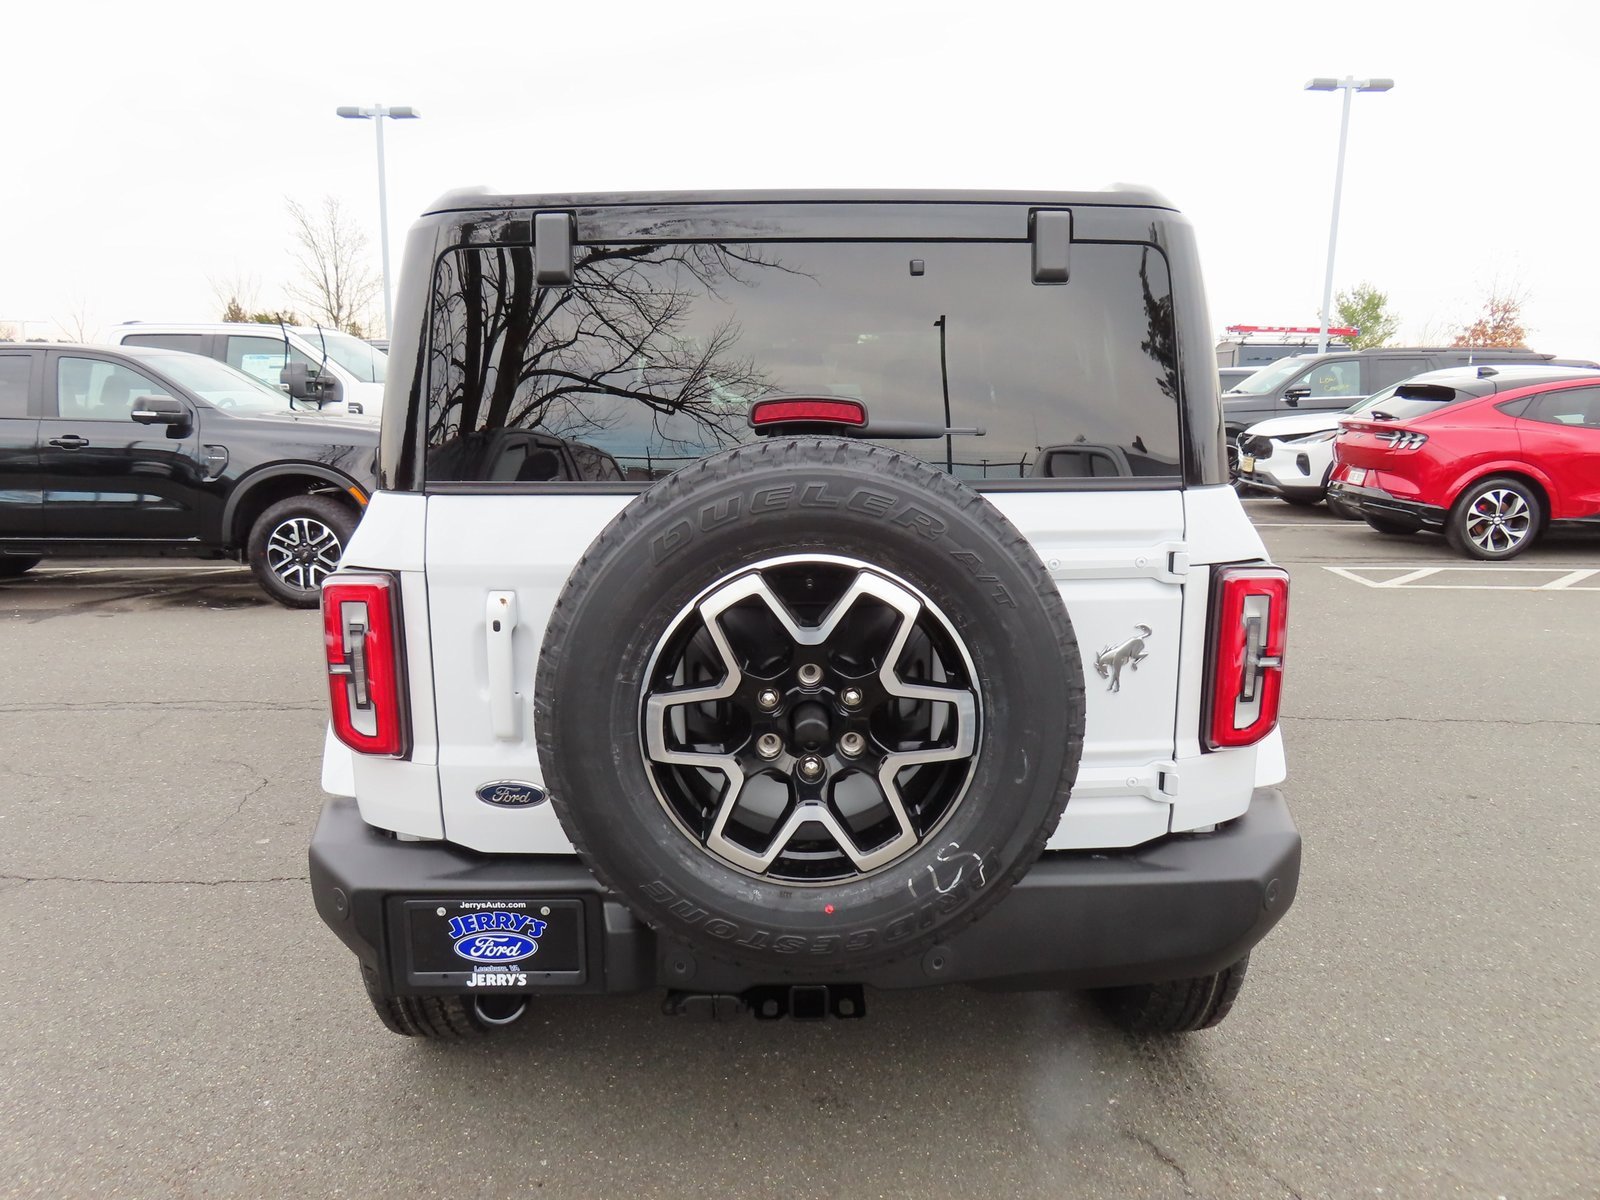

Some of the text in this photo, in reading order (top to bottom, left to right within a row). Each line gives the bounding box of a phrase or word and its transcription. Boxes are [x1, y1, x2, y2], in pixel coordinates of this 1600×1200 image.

[648, 481, 951, 566] DUELER
[492, 786, 531, 803] Ford
[639, 847, 999, 955] BRIDGESTONE
[449, 912, 547, 938] JERRY'S
[471, 937, 521, 956] Ford
[467, 974, 526, 986] JERRY'S
